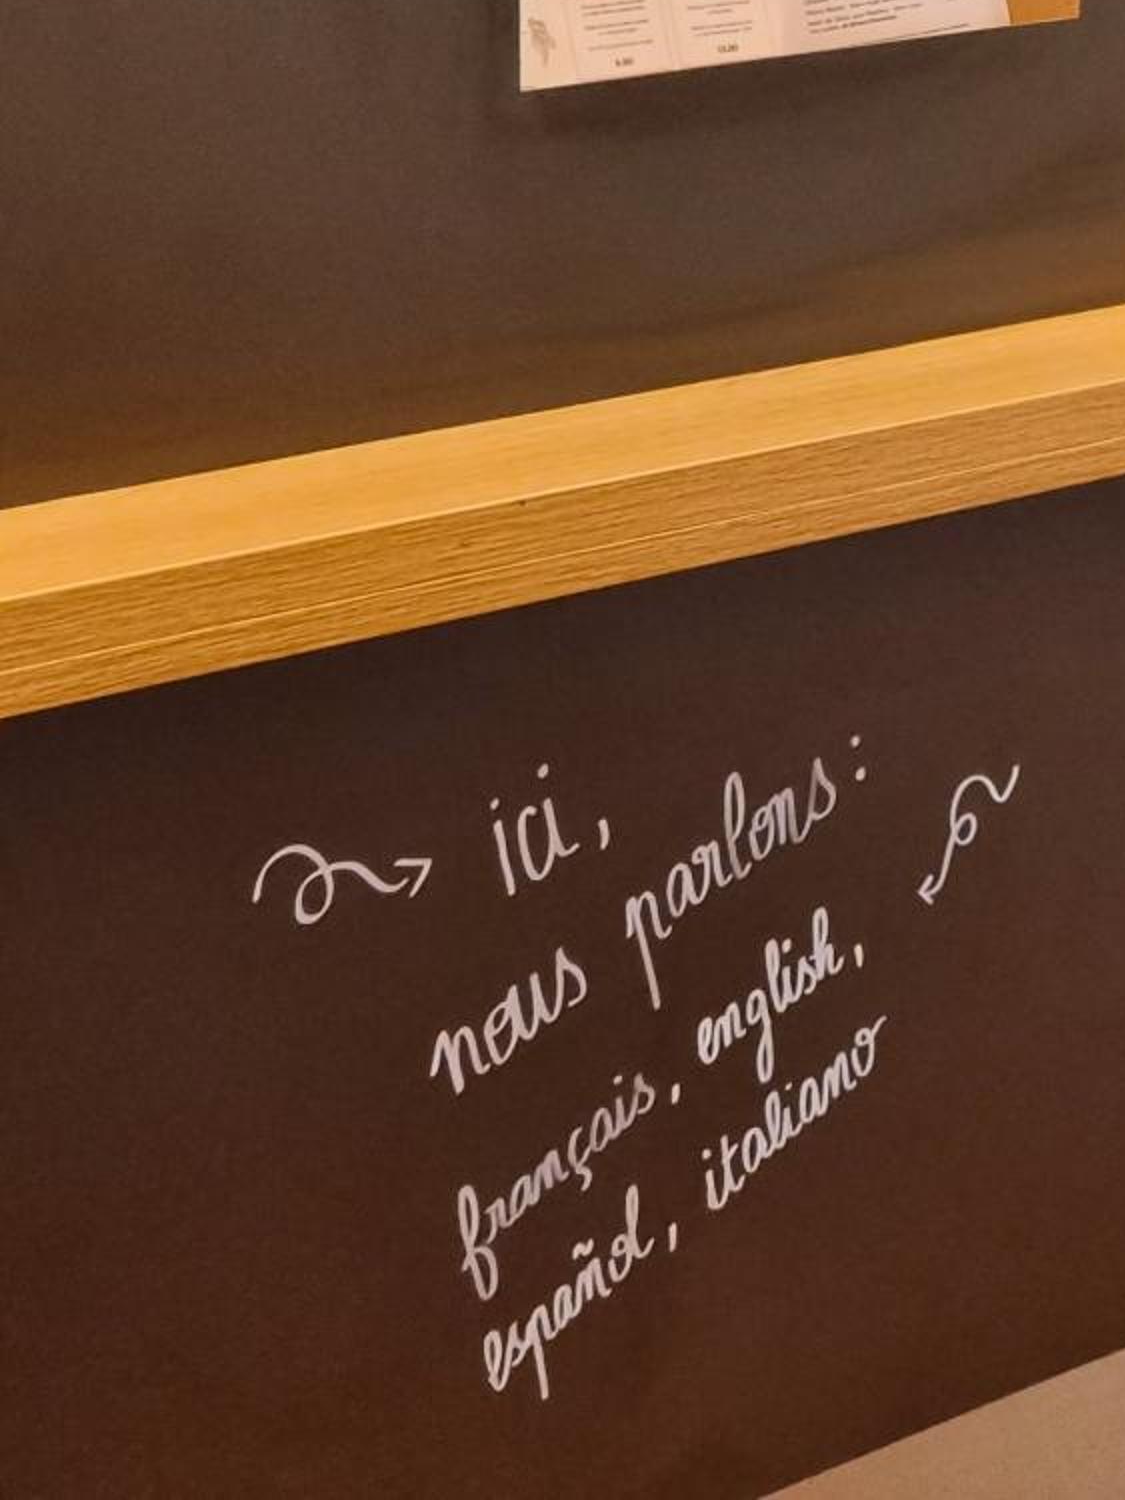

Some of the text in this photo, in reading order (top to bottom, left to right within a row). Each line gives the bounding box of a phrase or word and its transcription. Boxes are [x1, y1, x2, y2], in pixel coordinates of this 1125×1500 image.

[490, 763, 610, 896] ici,
[429, 947, 588, 1095] nous
[457, 906, 865, 1302] français, english,
[483, 1015, 888, 1401] español, italiano
